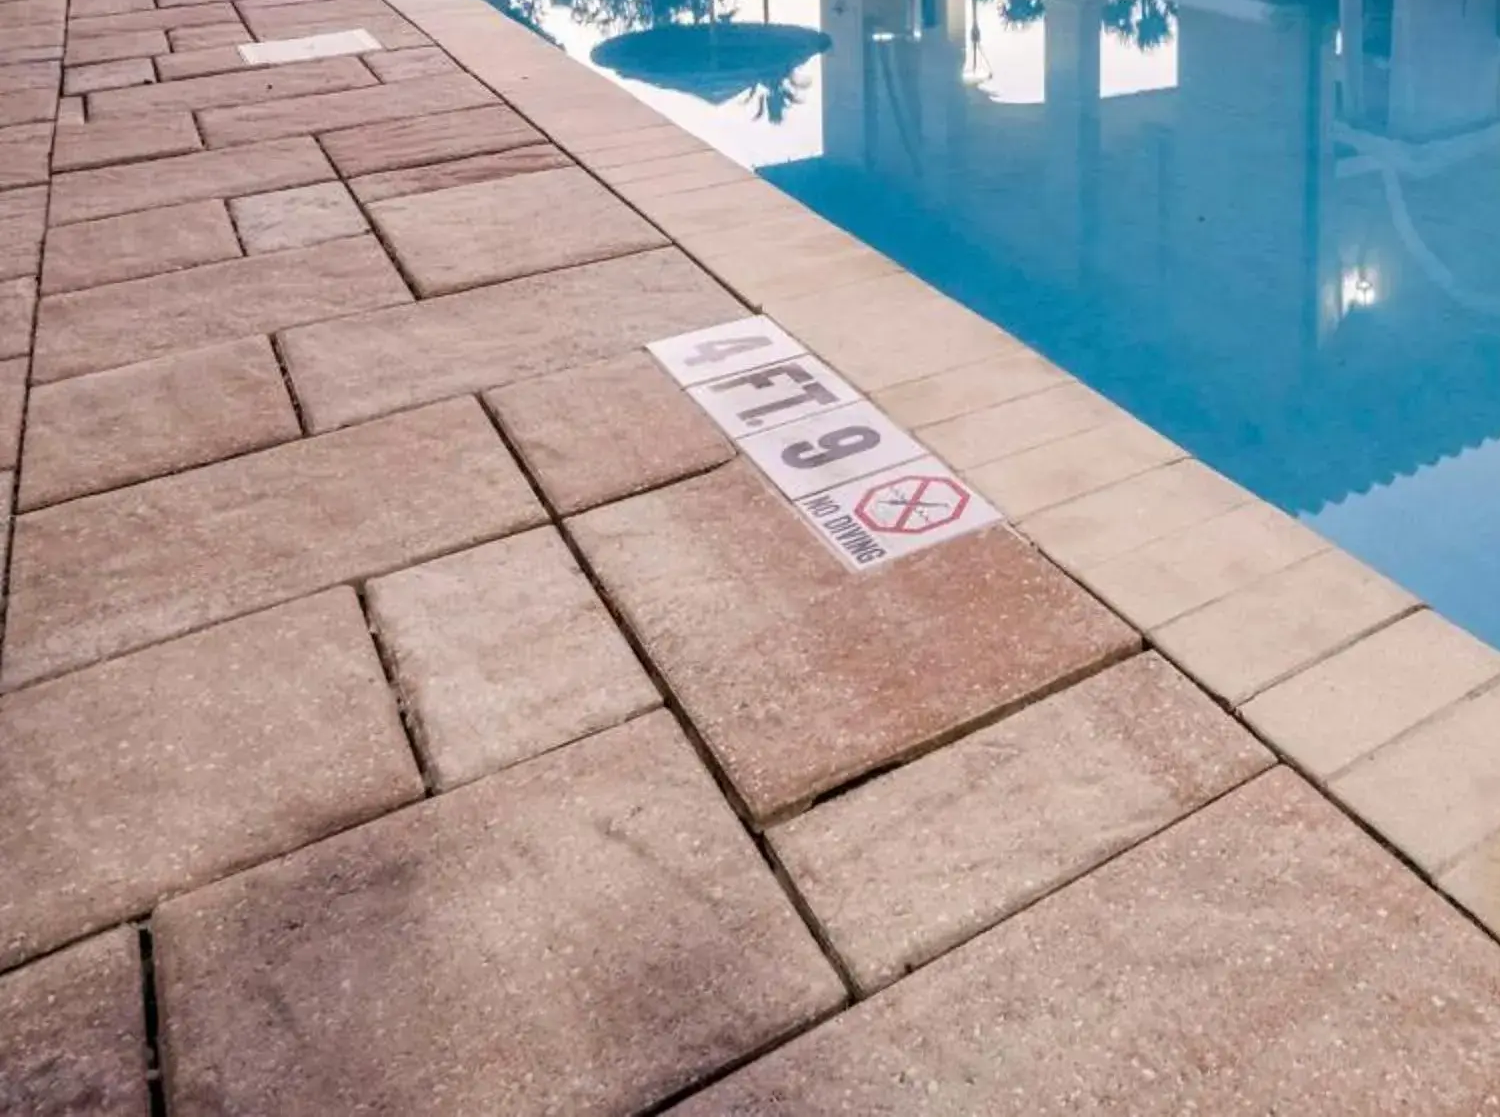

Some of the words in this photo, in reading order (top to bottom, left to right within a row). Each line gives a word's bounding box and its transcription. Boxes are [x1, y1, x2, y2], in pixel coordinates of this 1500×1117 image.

[685, 335, 774, 367] 4
[710, 363, 841, 428] FT.
[780, 425, 882, 470] 9
[803, 494, 840, 519] NO
[822, 512, 888, 565] DIVING
